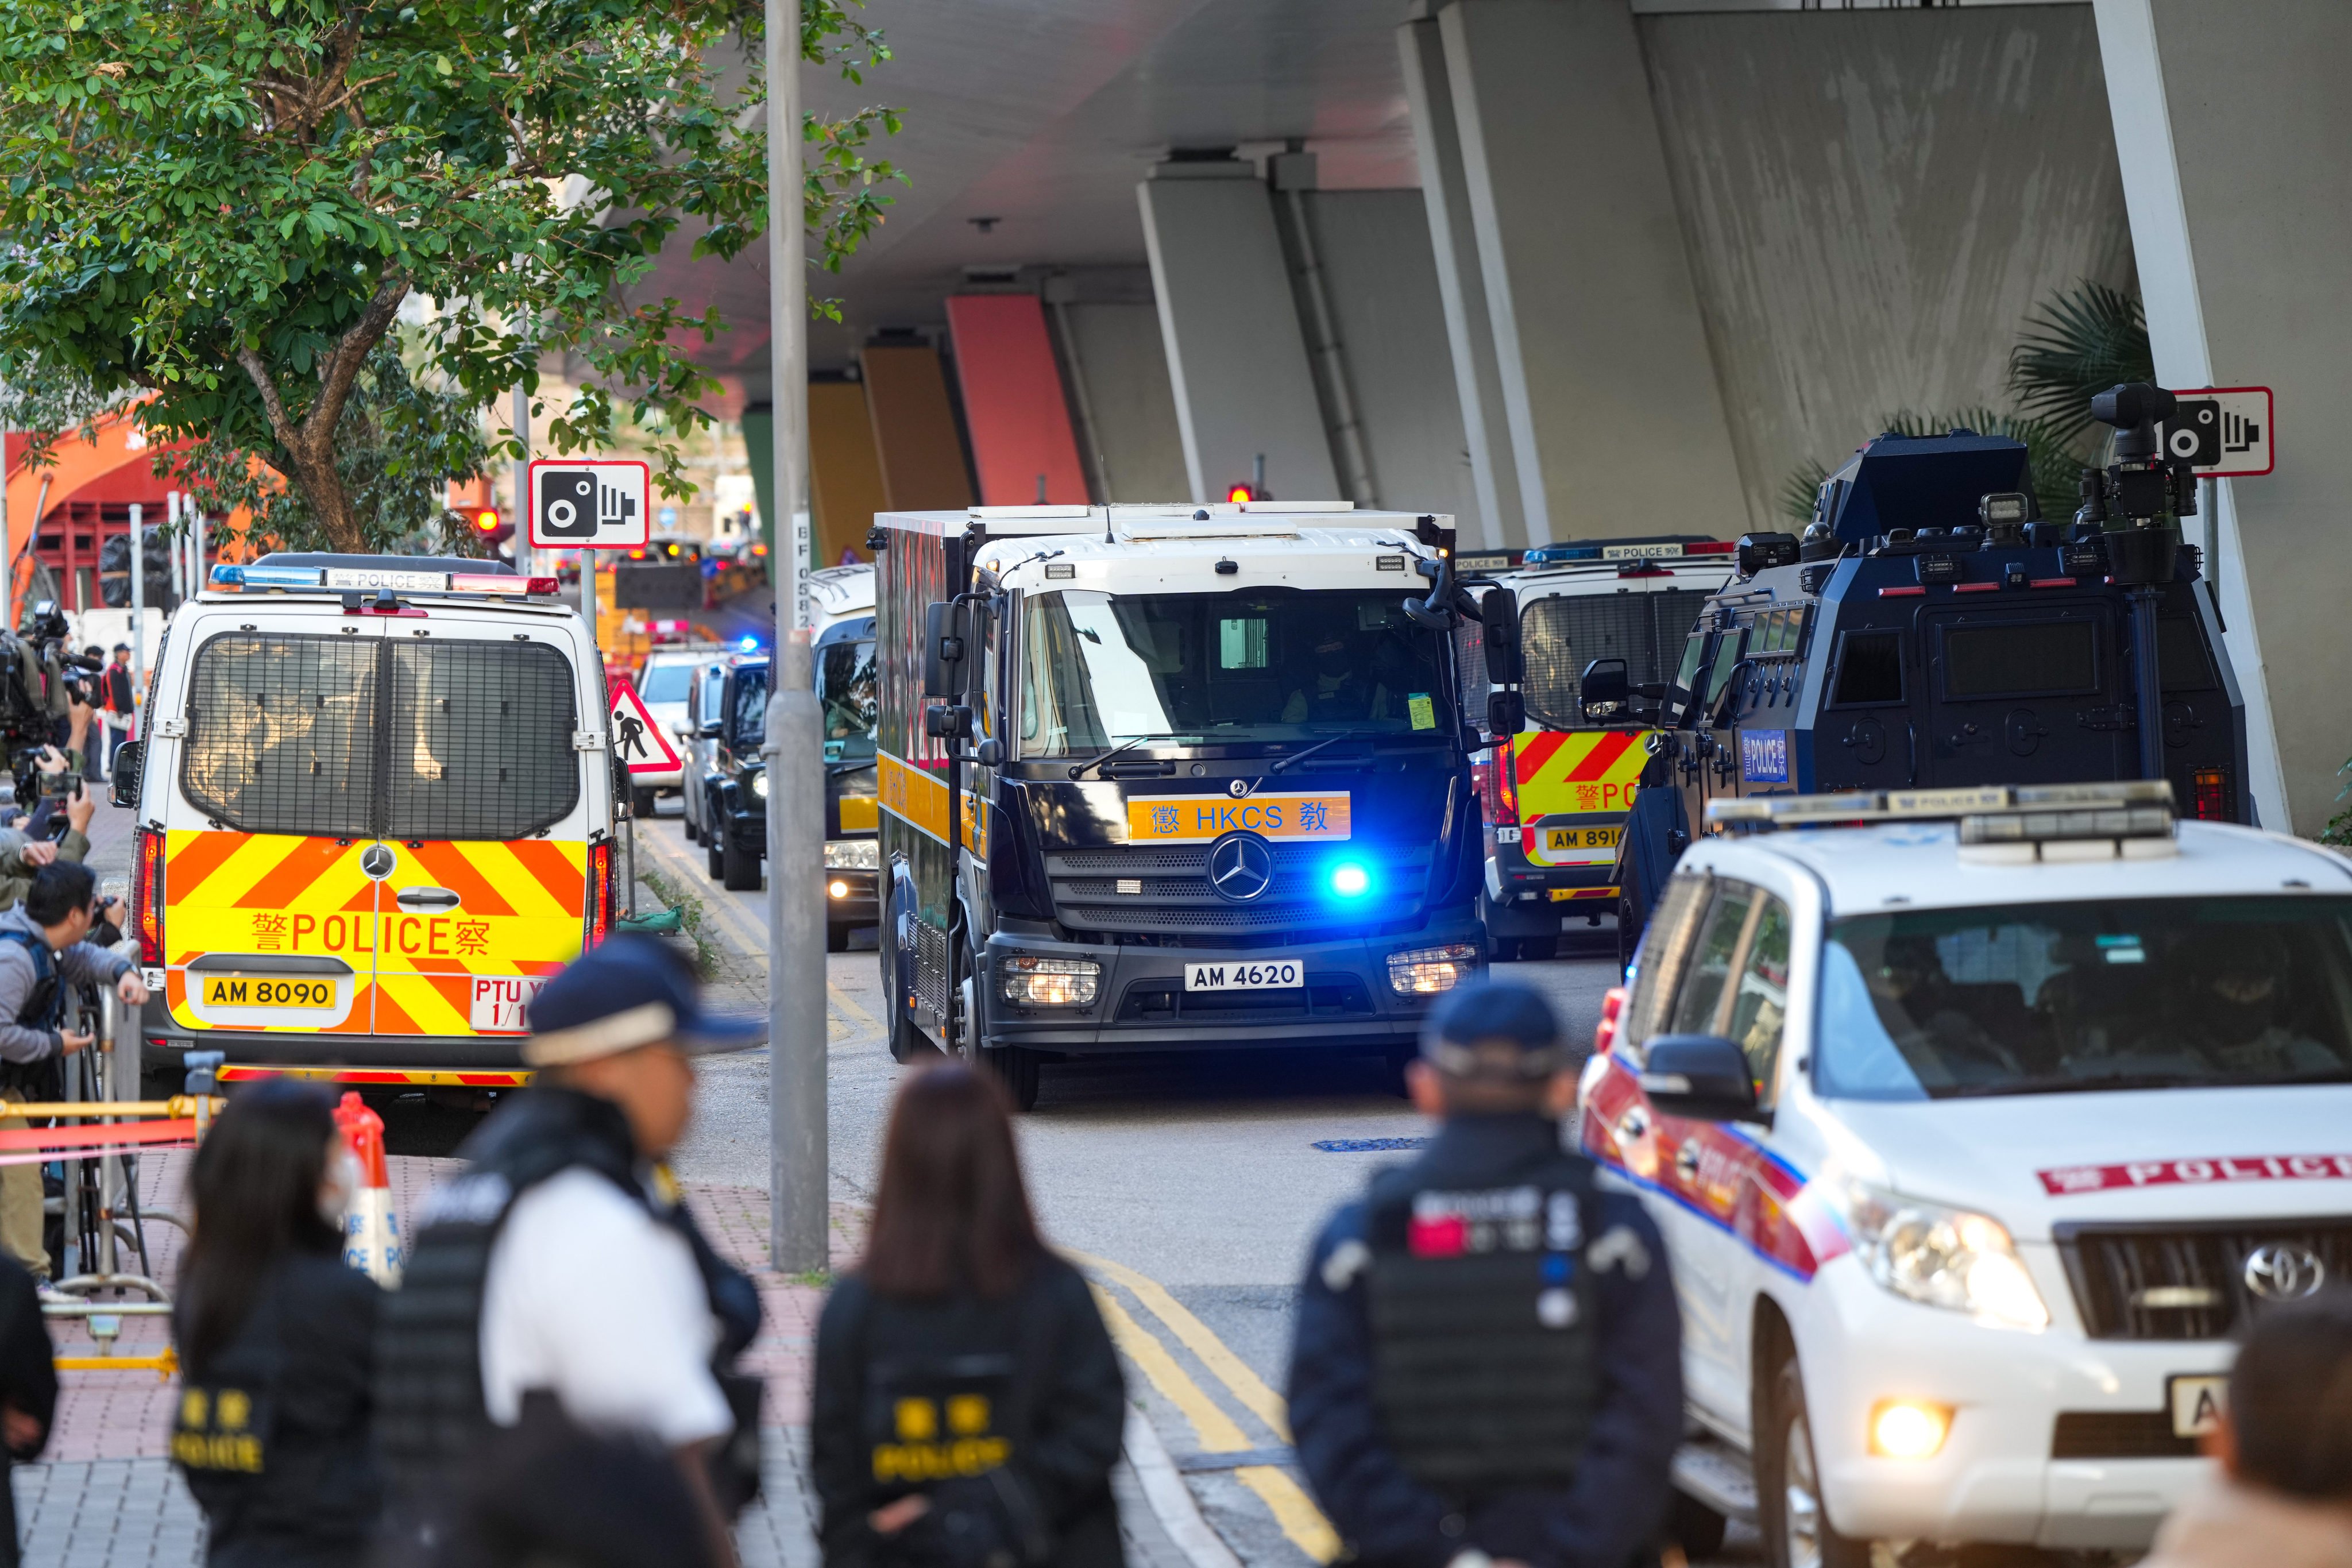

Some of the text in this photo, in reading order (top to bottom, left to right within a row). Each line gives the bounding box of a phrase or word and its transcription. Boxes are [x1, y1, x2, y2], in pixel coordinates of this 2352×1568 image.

[1455, 559, 1489, 569] POLICE
[1624, 547, 1662, 558] POLICE
[358, 573, 415, 588] POLICE
[1751, 739, 1778, 774] POLICE
[1575, 784, 1600, 810] 警
[1150, 805, 1180, 833] 懲
[1197, 806, 1283, 830] HKCS
[1555, 830, 1622, 847] AM 891
[251, 912, 490, 956] 警 POLICE 察
[1194, 965, 1295, 987] AM 4620
[211, 980, 328, 1004] AM 8090
[476, 979, 521, 1003] PTU
